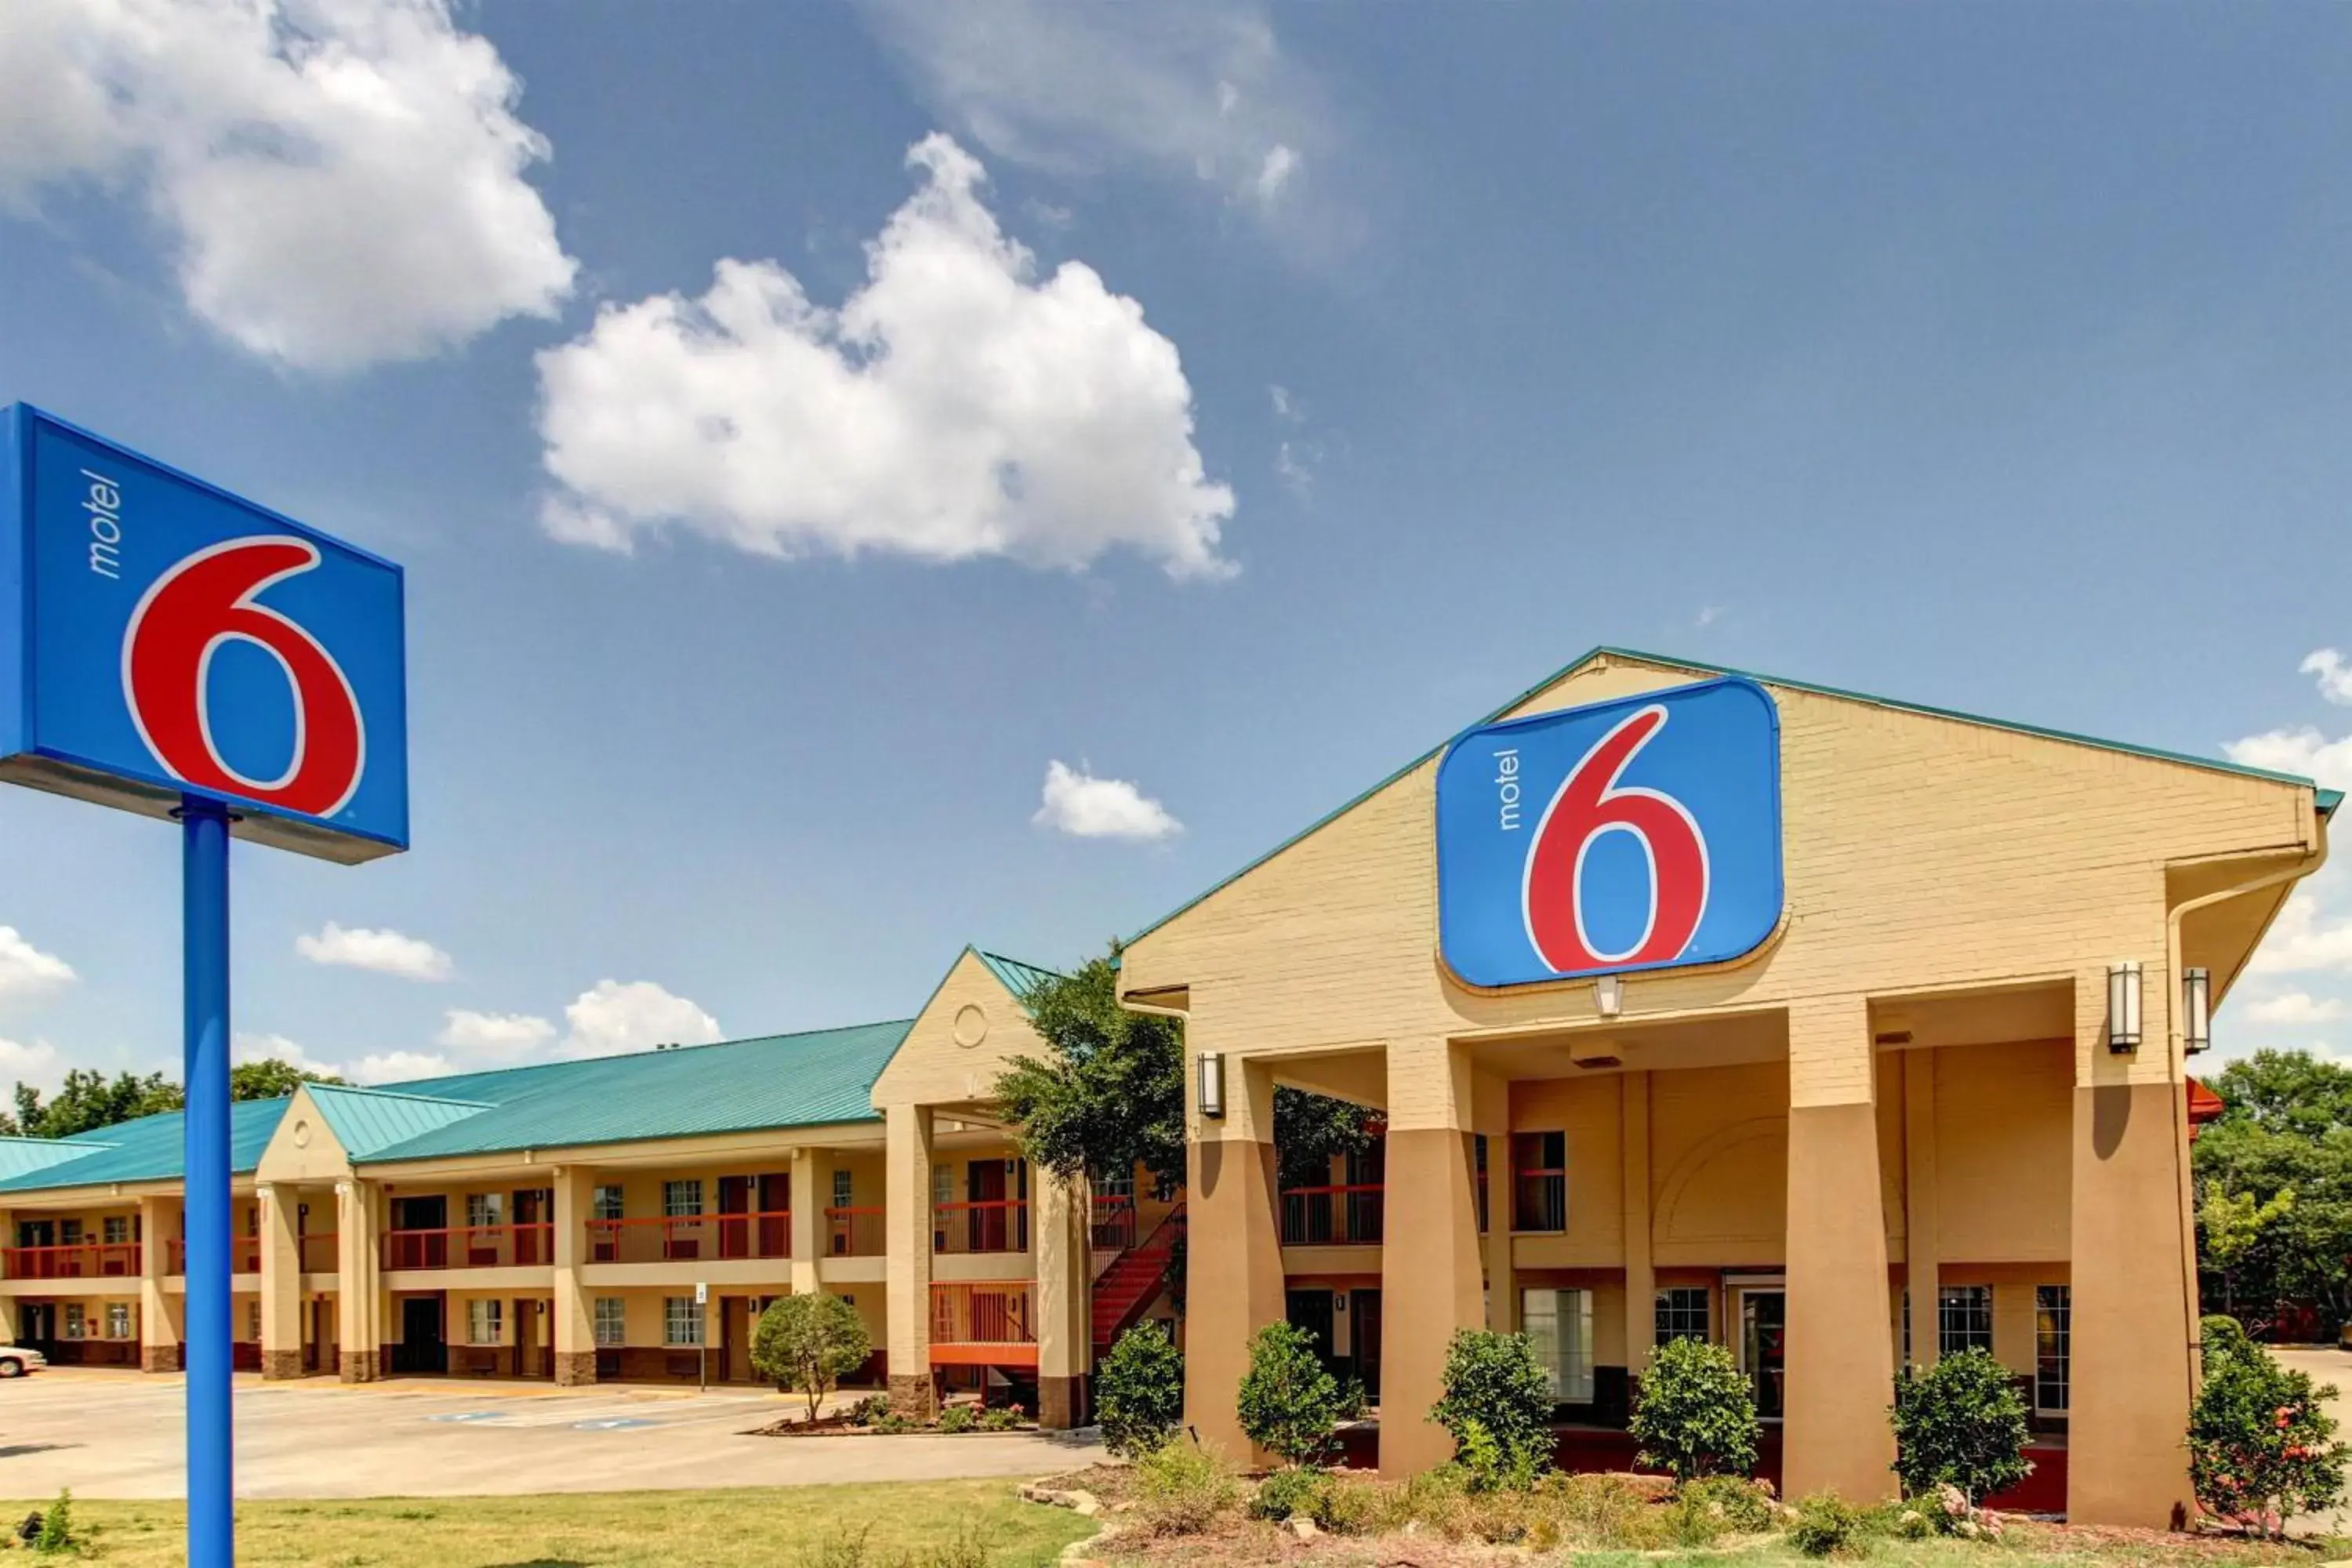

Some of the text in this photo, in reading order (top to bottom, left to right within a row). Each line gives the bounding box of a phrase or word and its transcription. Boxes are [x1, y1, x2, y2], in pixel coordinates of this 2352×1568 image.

[81, 469, 120, 579] motel
[121, 535, 366, 818] 6
[1493, 748, 1520, 830] motel
[1522, 704, 1709, 974] 6
